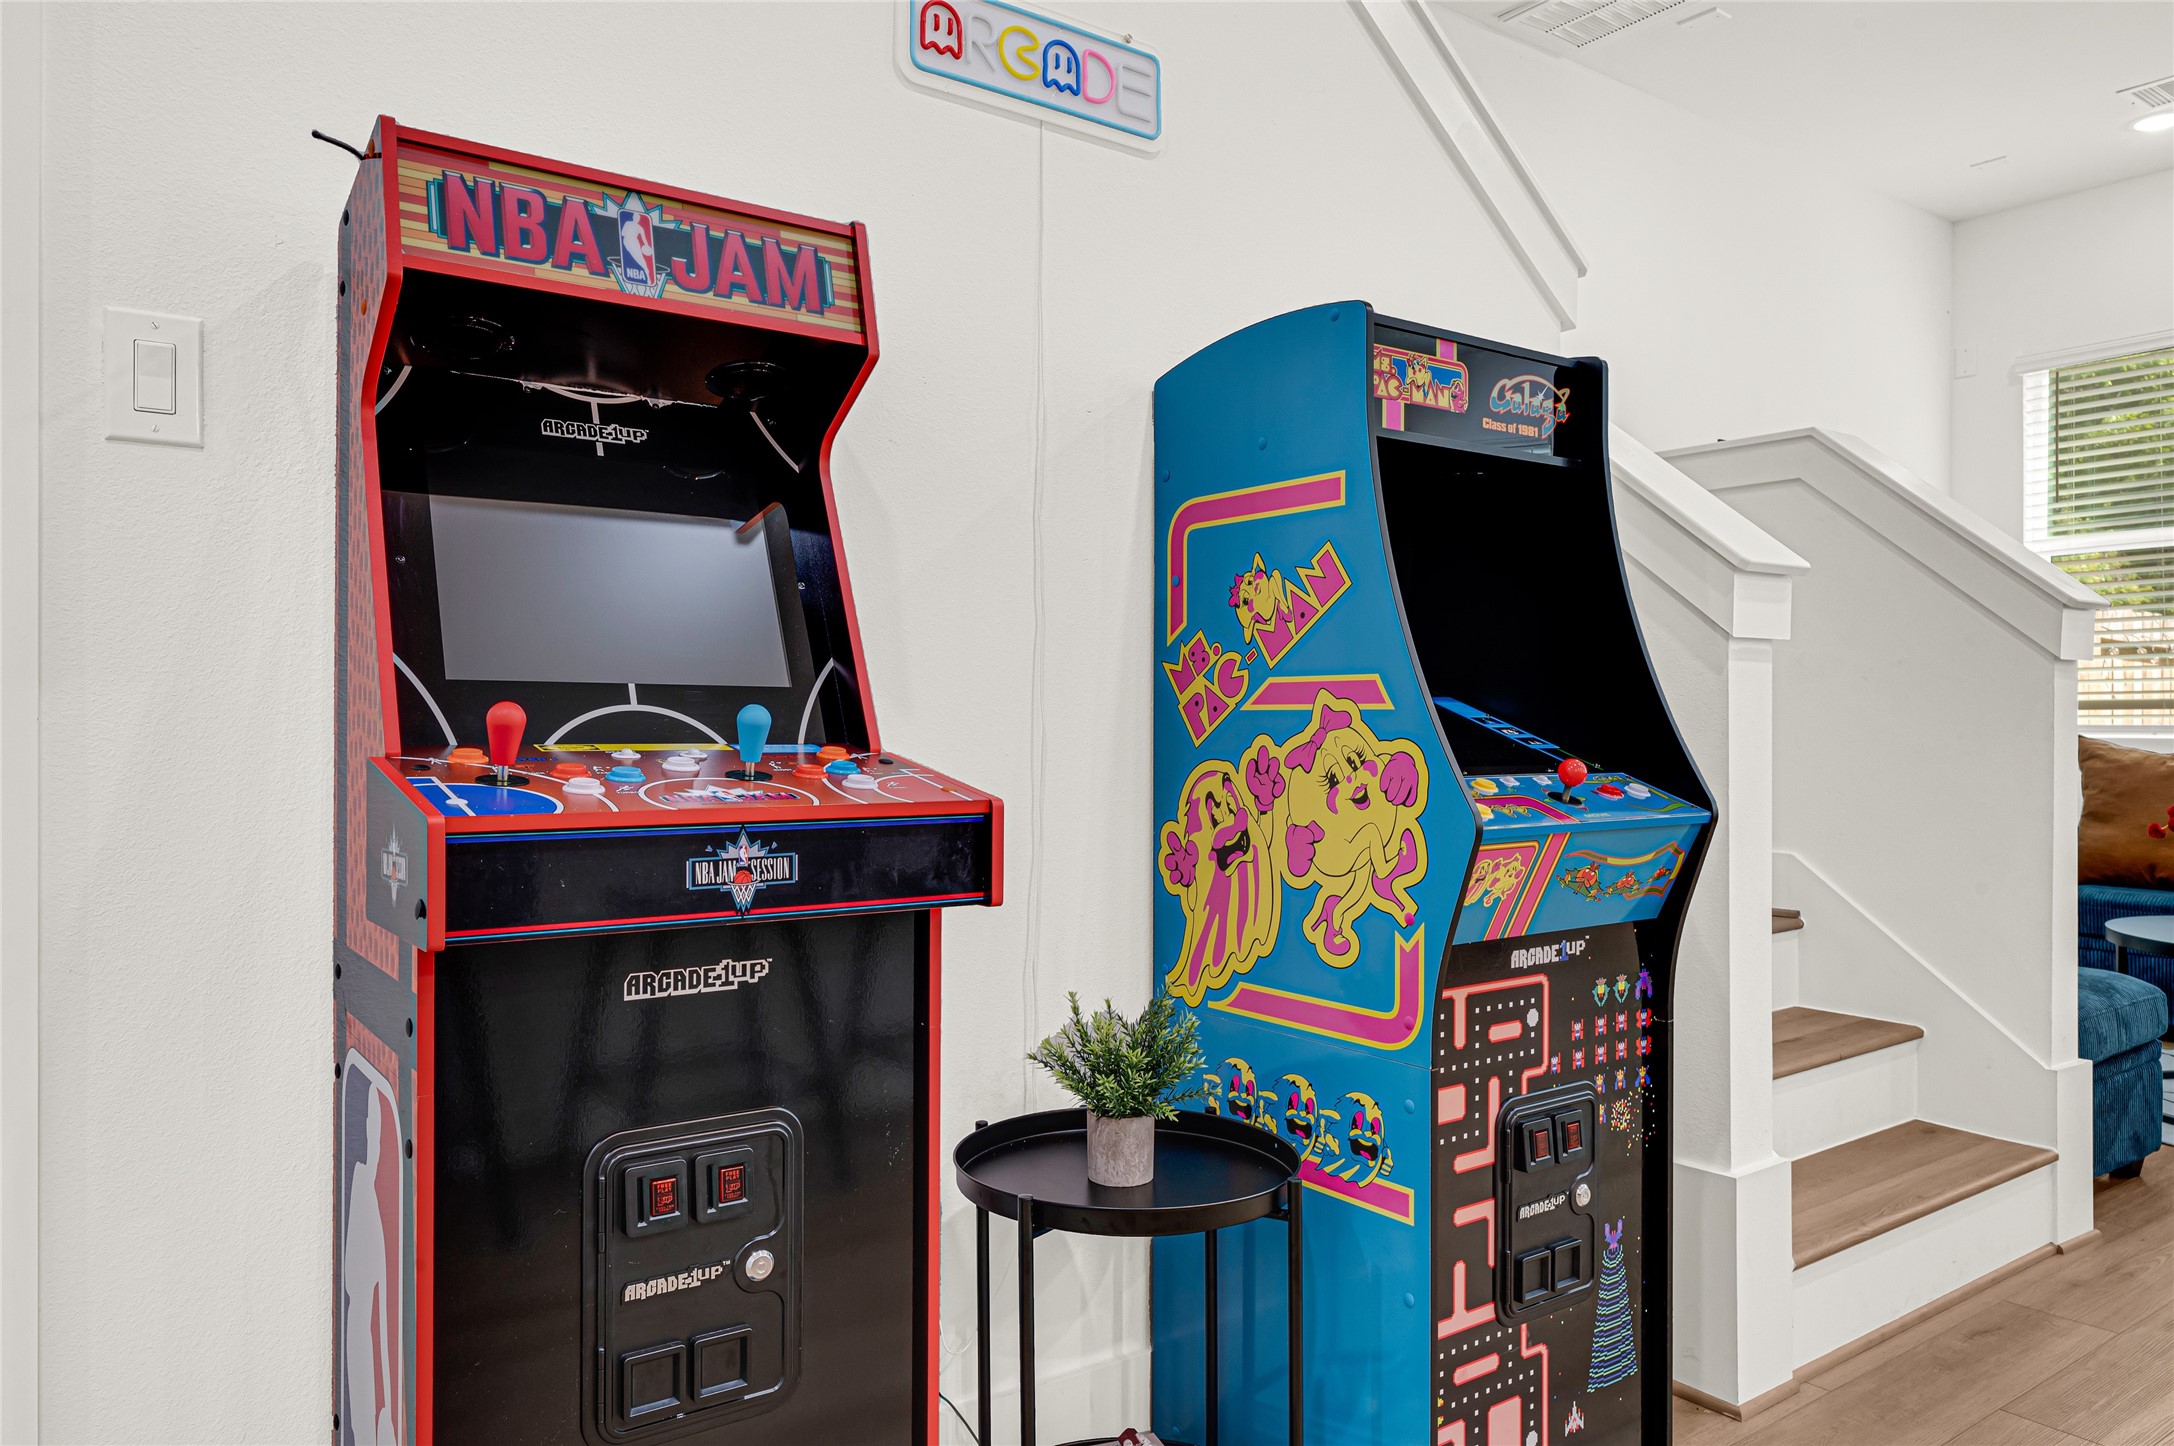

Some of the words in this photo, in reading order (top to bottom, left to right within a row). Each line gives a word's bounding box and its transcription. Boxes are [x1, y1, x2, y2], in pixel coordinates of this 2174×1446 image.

[919, 0, 1152, 124] ARCADE
[442, 170, 610, 278] NBA
[671, 221, 824, 315] JAM
[626, 267, 646, 281] NBA
[1482, 417, 1507, 432] Class
[1507, 422, 1517, 434] of
[1517, 424, 1539, 438] 1981
[695, 861, 716, 885] NBA
[716, 859, 737, 884] JAM
[751, 856, 790, 882] SESSION
[1511, 939, 1586, 969] ARCADE1UP
